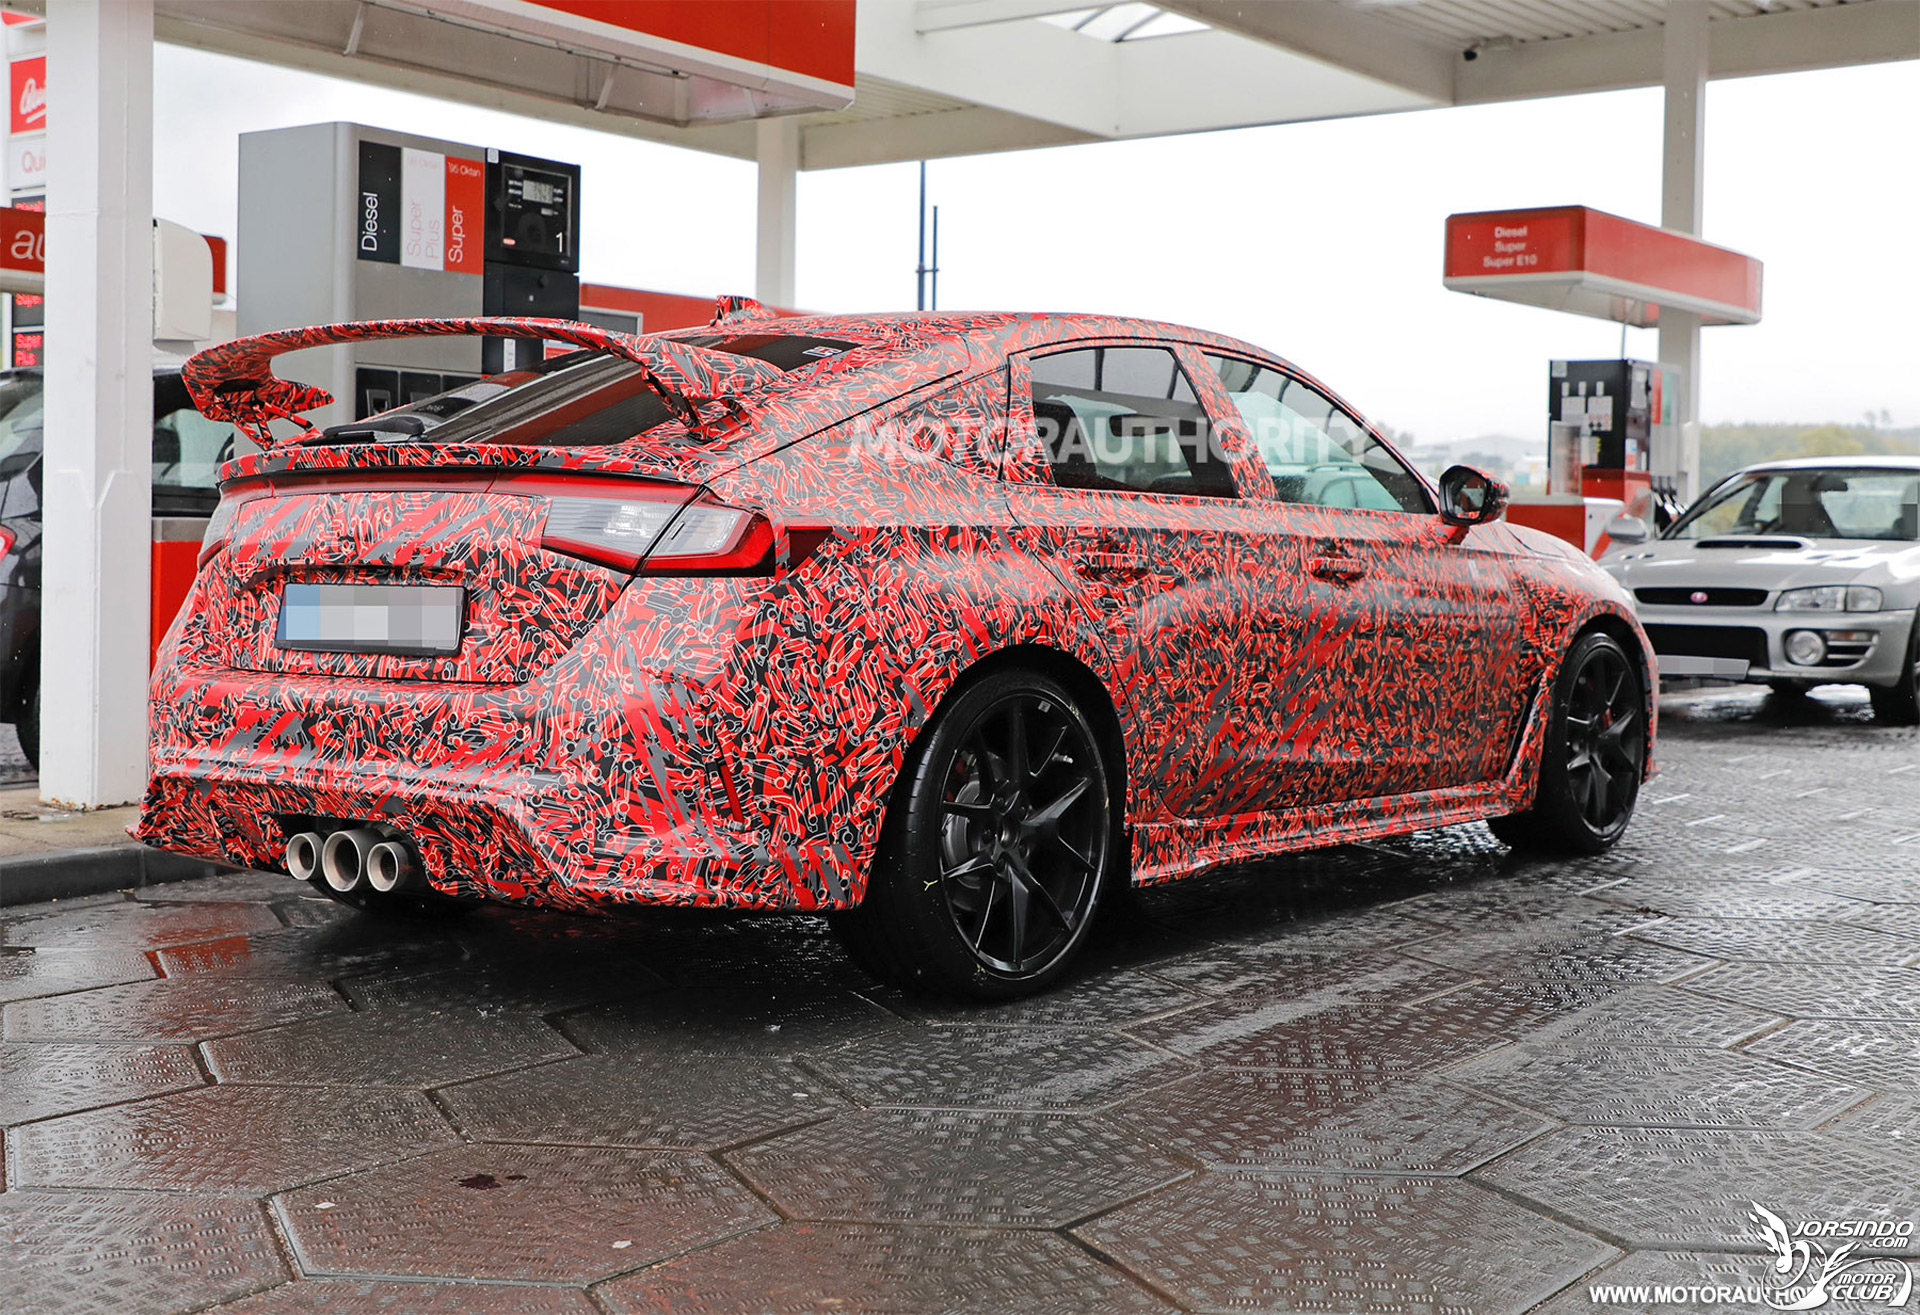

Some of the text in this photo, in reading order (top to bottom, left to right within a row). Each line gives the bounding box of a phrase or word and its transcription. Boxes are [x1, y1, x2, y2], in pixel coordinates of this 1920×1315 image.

[361, 191, 379, 252] Diesel
[406, 198, 424, 257] Super
[448, 204, 466, 264] Super
[1494, 226, 1527, 238] Diesel
[425, 219, 440, 260] Plus
[556, 232, 563, 253] 1
[1494, 241, 1526, 253] Super
[1483, 254, 1537, 268] Super E10
